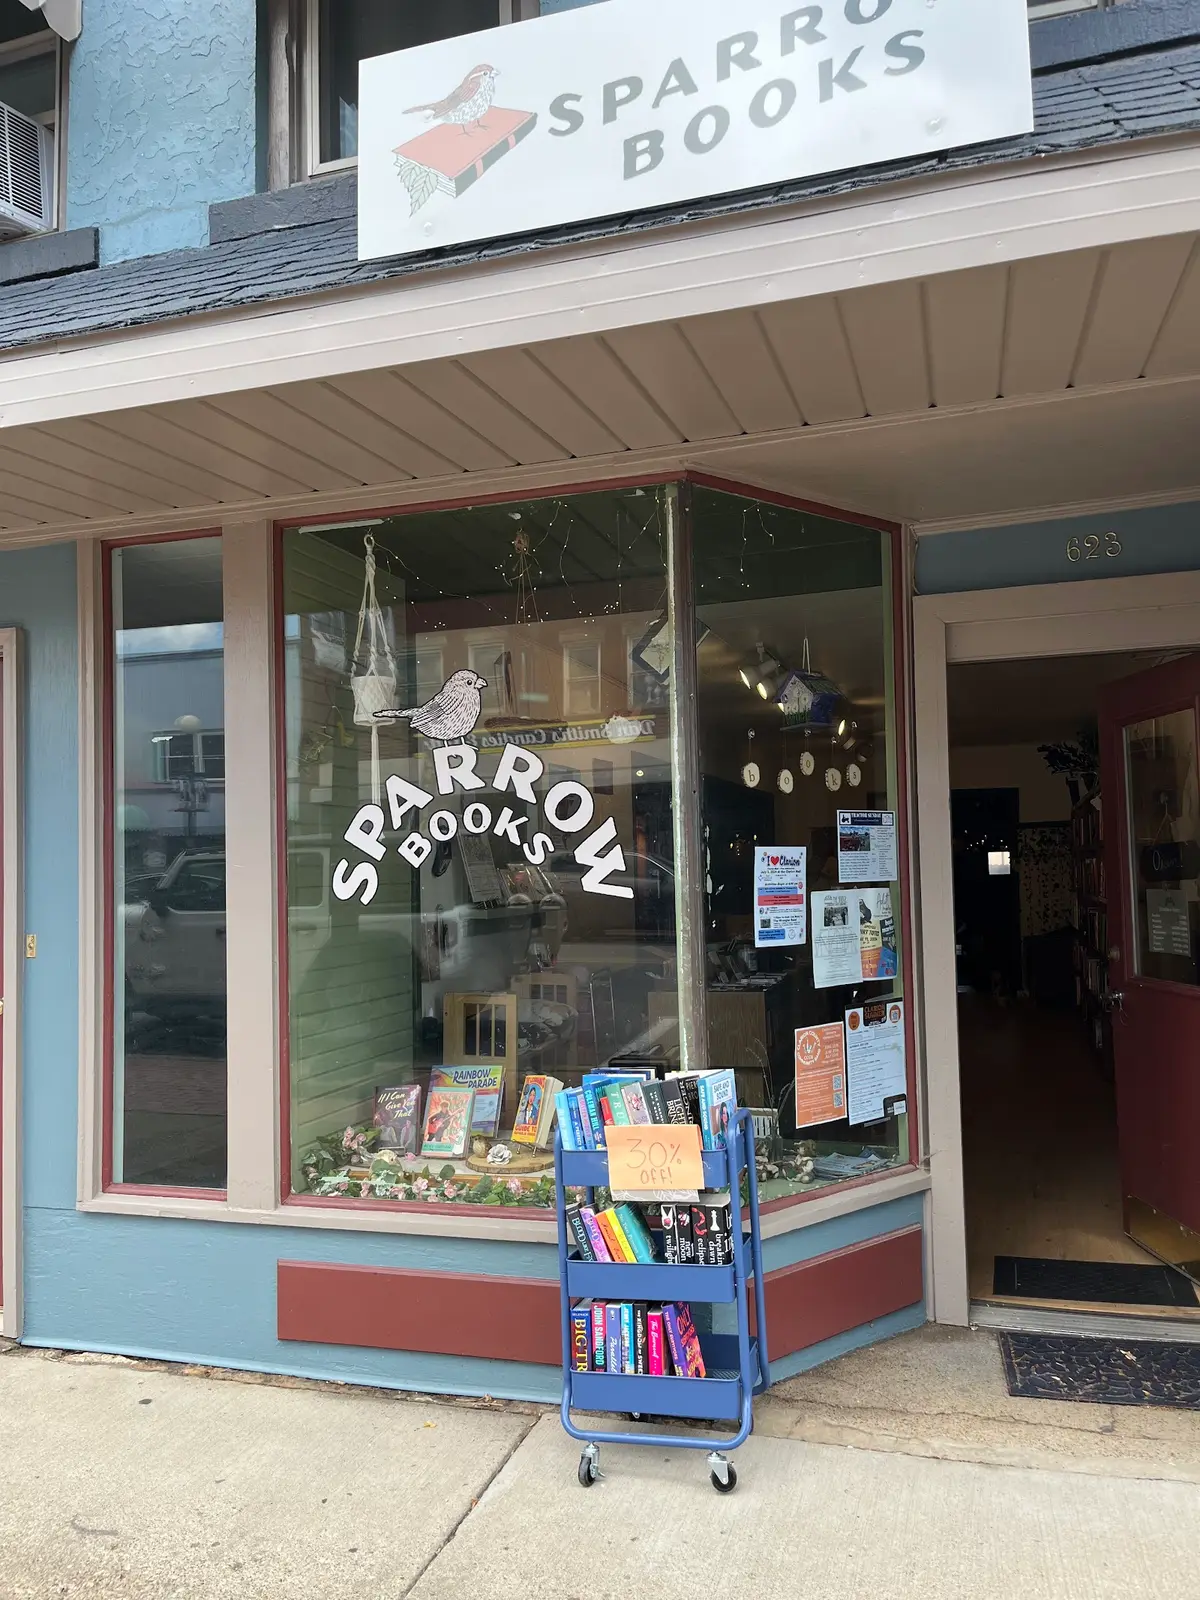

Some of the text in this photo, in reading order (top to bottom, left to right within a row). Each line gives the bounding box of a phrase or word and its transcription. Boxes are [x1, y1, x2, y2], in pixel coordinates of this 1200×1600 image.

[621, 29, 926, 181] BOOKS
[1066, 532, 1122, 562] 623
[332, 743, 635, 906] SPARROW
[397, 802, 556, 868] BOOKS
[780, 855, 800, 867] Clarion
[453, 1068, 492, 1084] RAINBOW
[467, 1076, 498, 1089] PARADE
[385, 1101, 402, 1110] Give
[390, 1091, 406, 1101] Can
[673, 1098, 687, 1124] LIGHT
[626, 1139, 682, 1168] 30%
[572, 1217, 587, 1243] BLOOD
[679, 1237, 687, 1262] moon
[708, 1240, 718, 1264] dawn
[574, 1318, 588, 1347] BIG
[593, 1305, 605, 1366] JOHN SANDFORD
